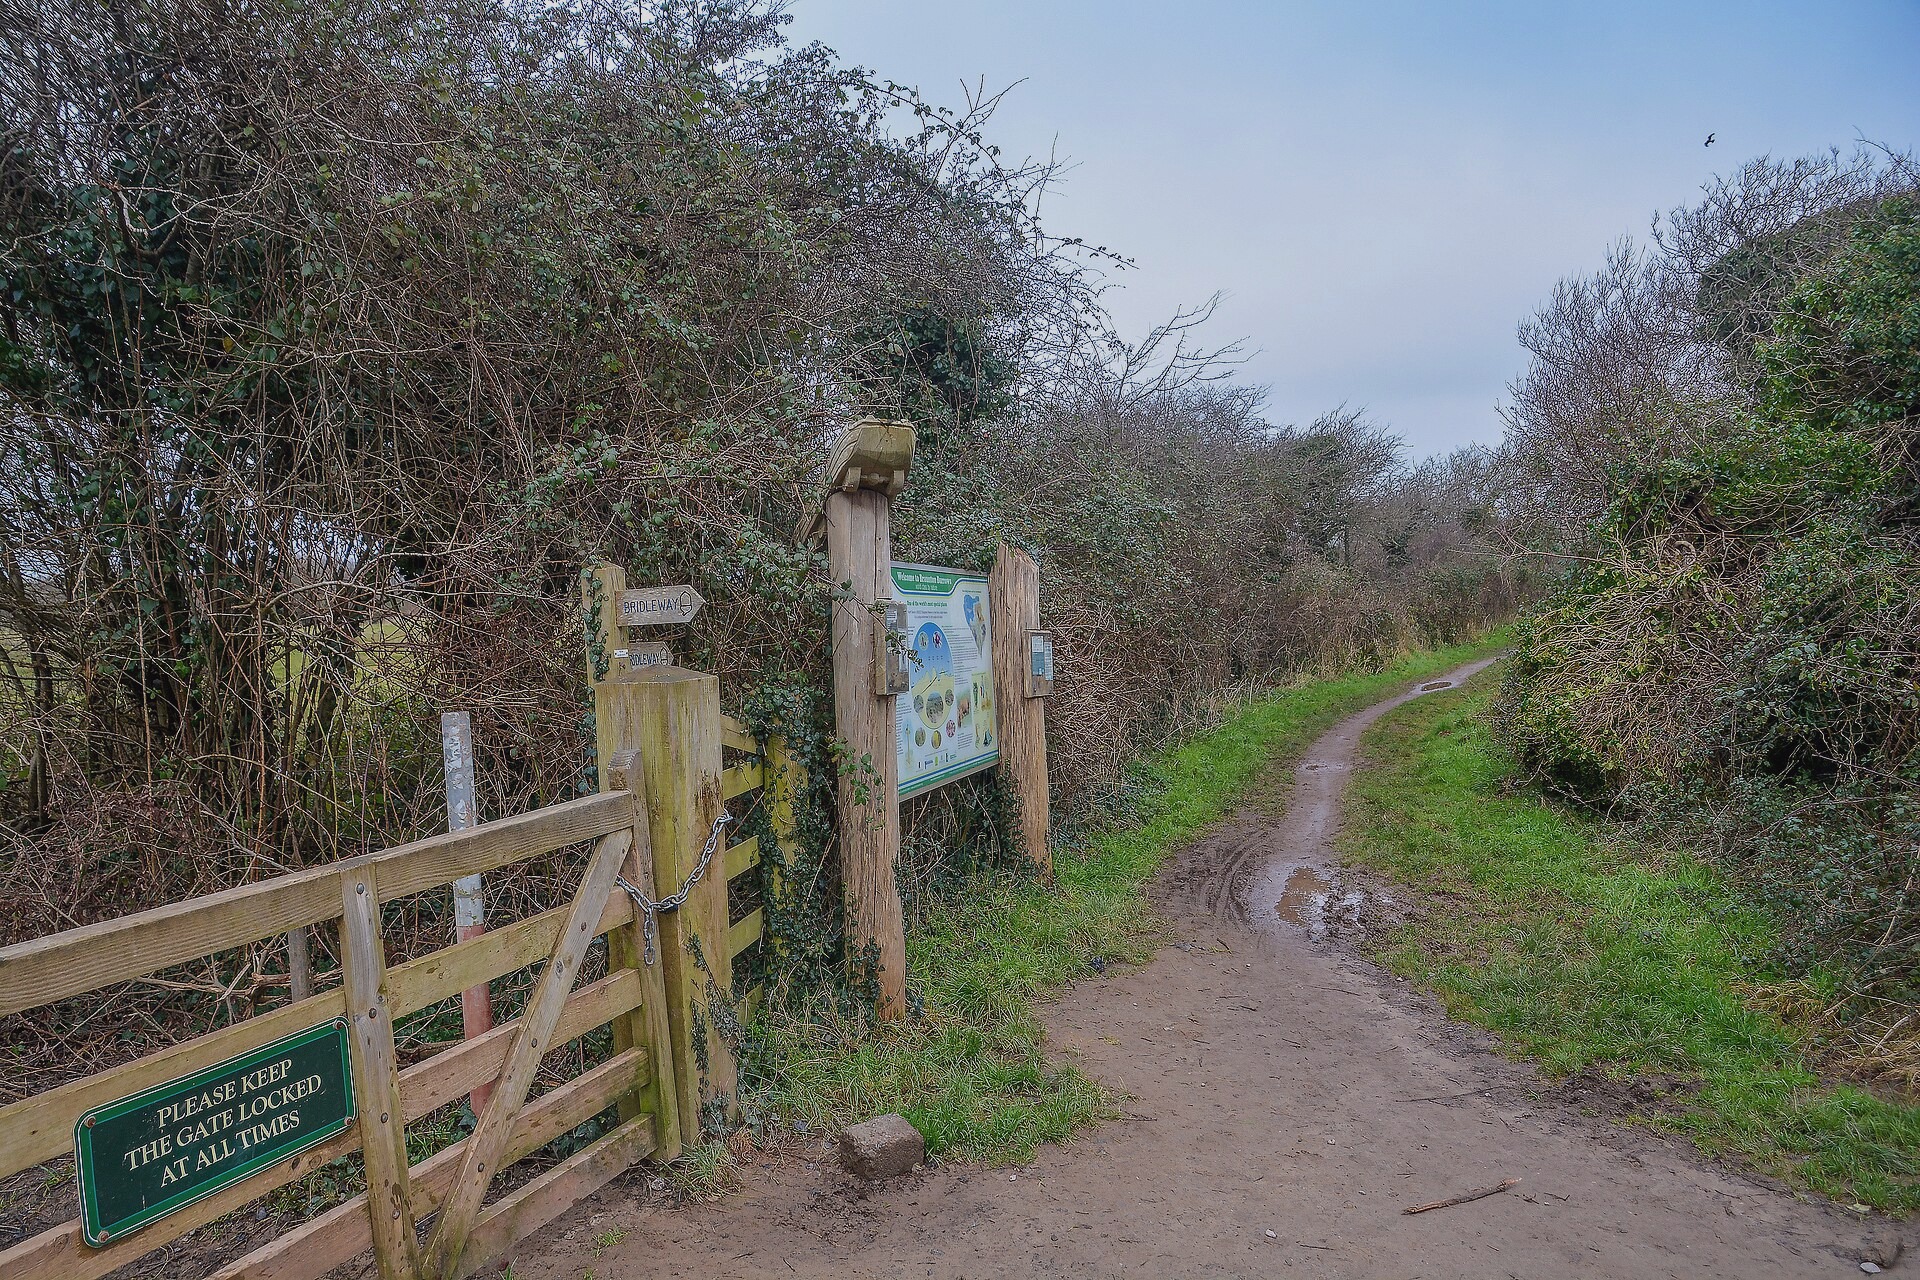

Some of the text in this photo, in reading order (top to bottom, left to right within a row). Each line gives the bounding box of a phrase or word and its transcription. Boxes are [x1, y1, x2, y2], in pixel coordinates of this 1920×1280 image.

[624, 598, 678, 613] BRIDLEWAY
[124, 1074, 322, 1172] THE GATE LOCKED
[157, 1058, 293, 1129] PLEASE KEEP
[160, 1109, 300, 1188] AT ALL TIMES
